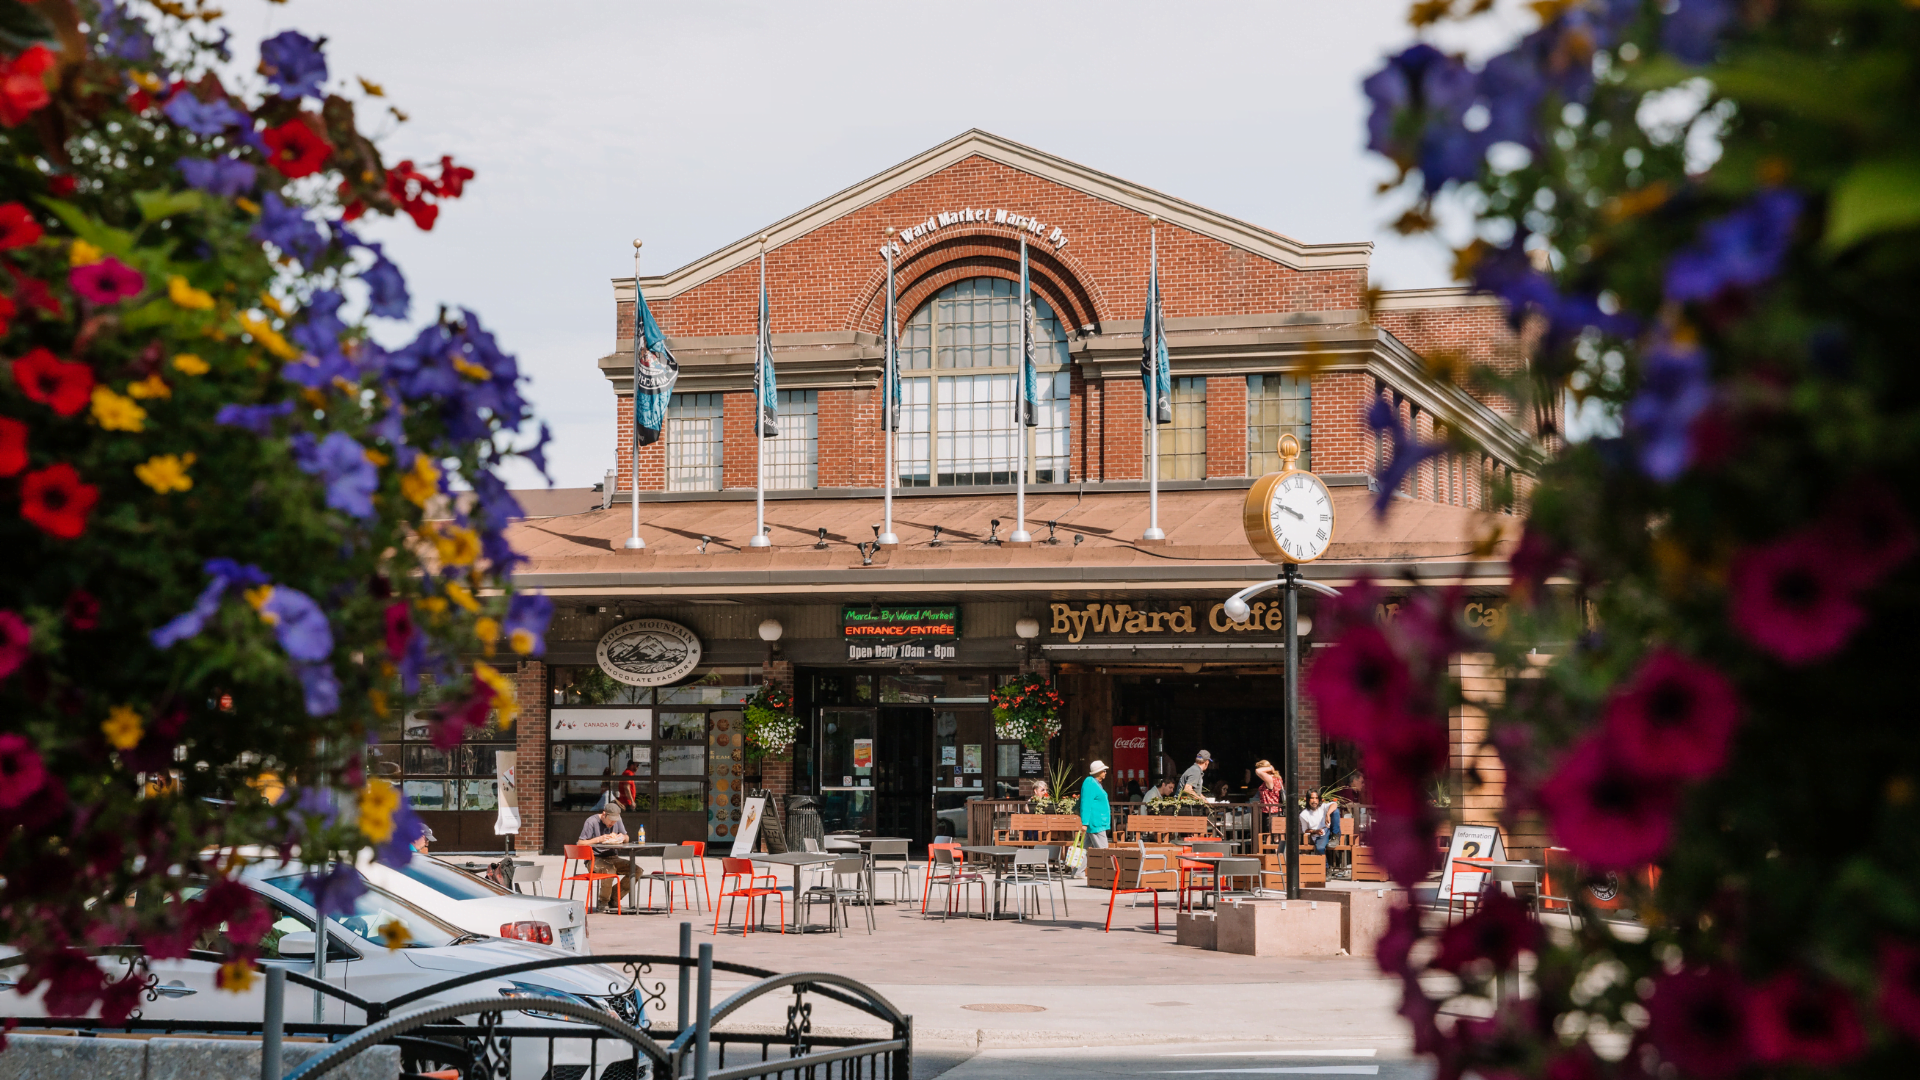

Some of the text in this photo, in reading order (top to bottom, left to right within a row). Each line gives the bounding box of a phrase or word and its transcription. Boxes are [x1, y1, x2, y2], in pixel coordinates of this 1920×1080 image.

[900, 216, 936, 244] Ward
[938, 207, 990, 228] Market
[1049, 226, 1069, 249] By
[1295, 477, 1303, 488] XII
[881, 611, 894, 622] By
[896, 611, 920, 620] Ward
[921, 610, 954, 620] Market
[1051, 603, 1196, 643] ByWard
[602, 621, 695, 646] ROCKY MOUNTAIN
[845, 624, 955, 635] ENTRANCE/ENTRÉE
[849, 645, 873, 660] Open
[875, 645, 898, 660] Daily
[901, 645, 925, 658] 10am
[934, 645, 955, 660] 8pm
[603, 660, 693, 683] CHOCOLATE FACTORY
[1457, 831, 1493, 840] Information
